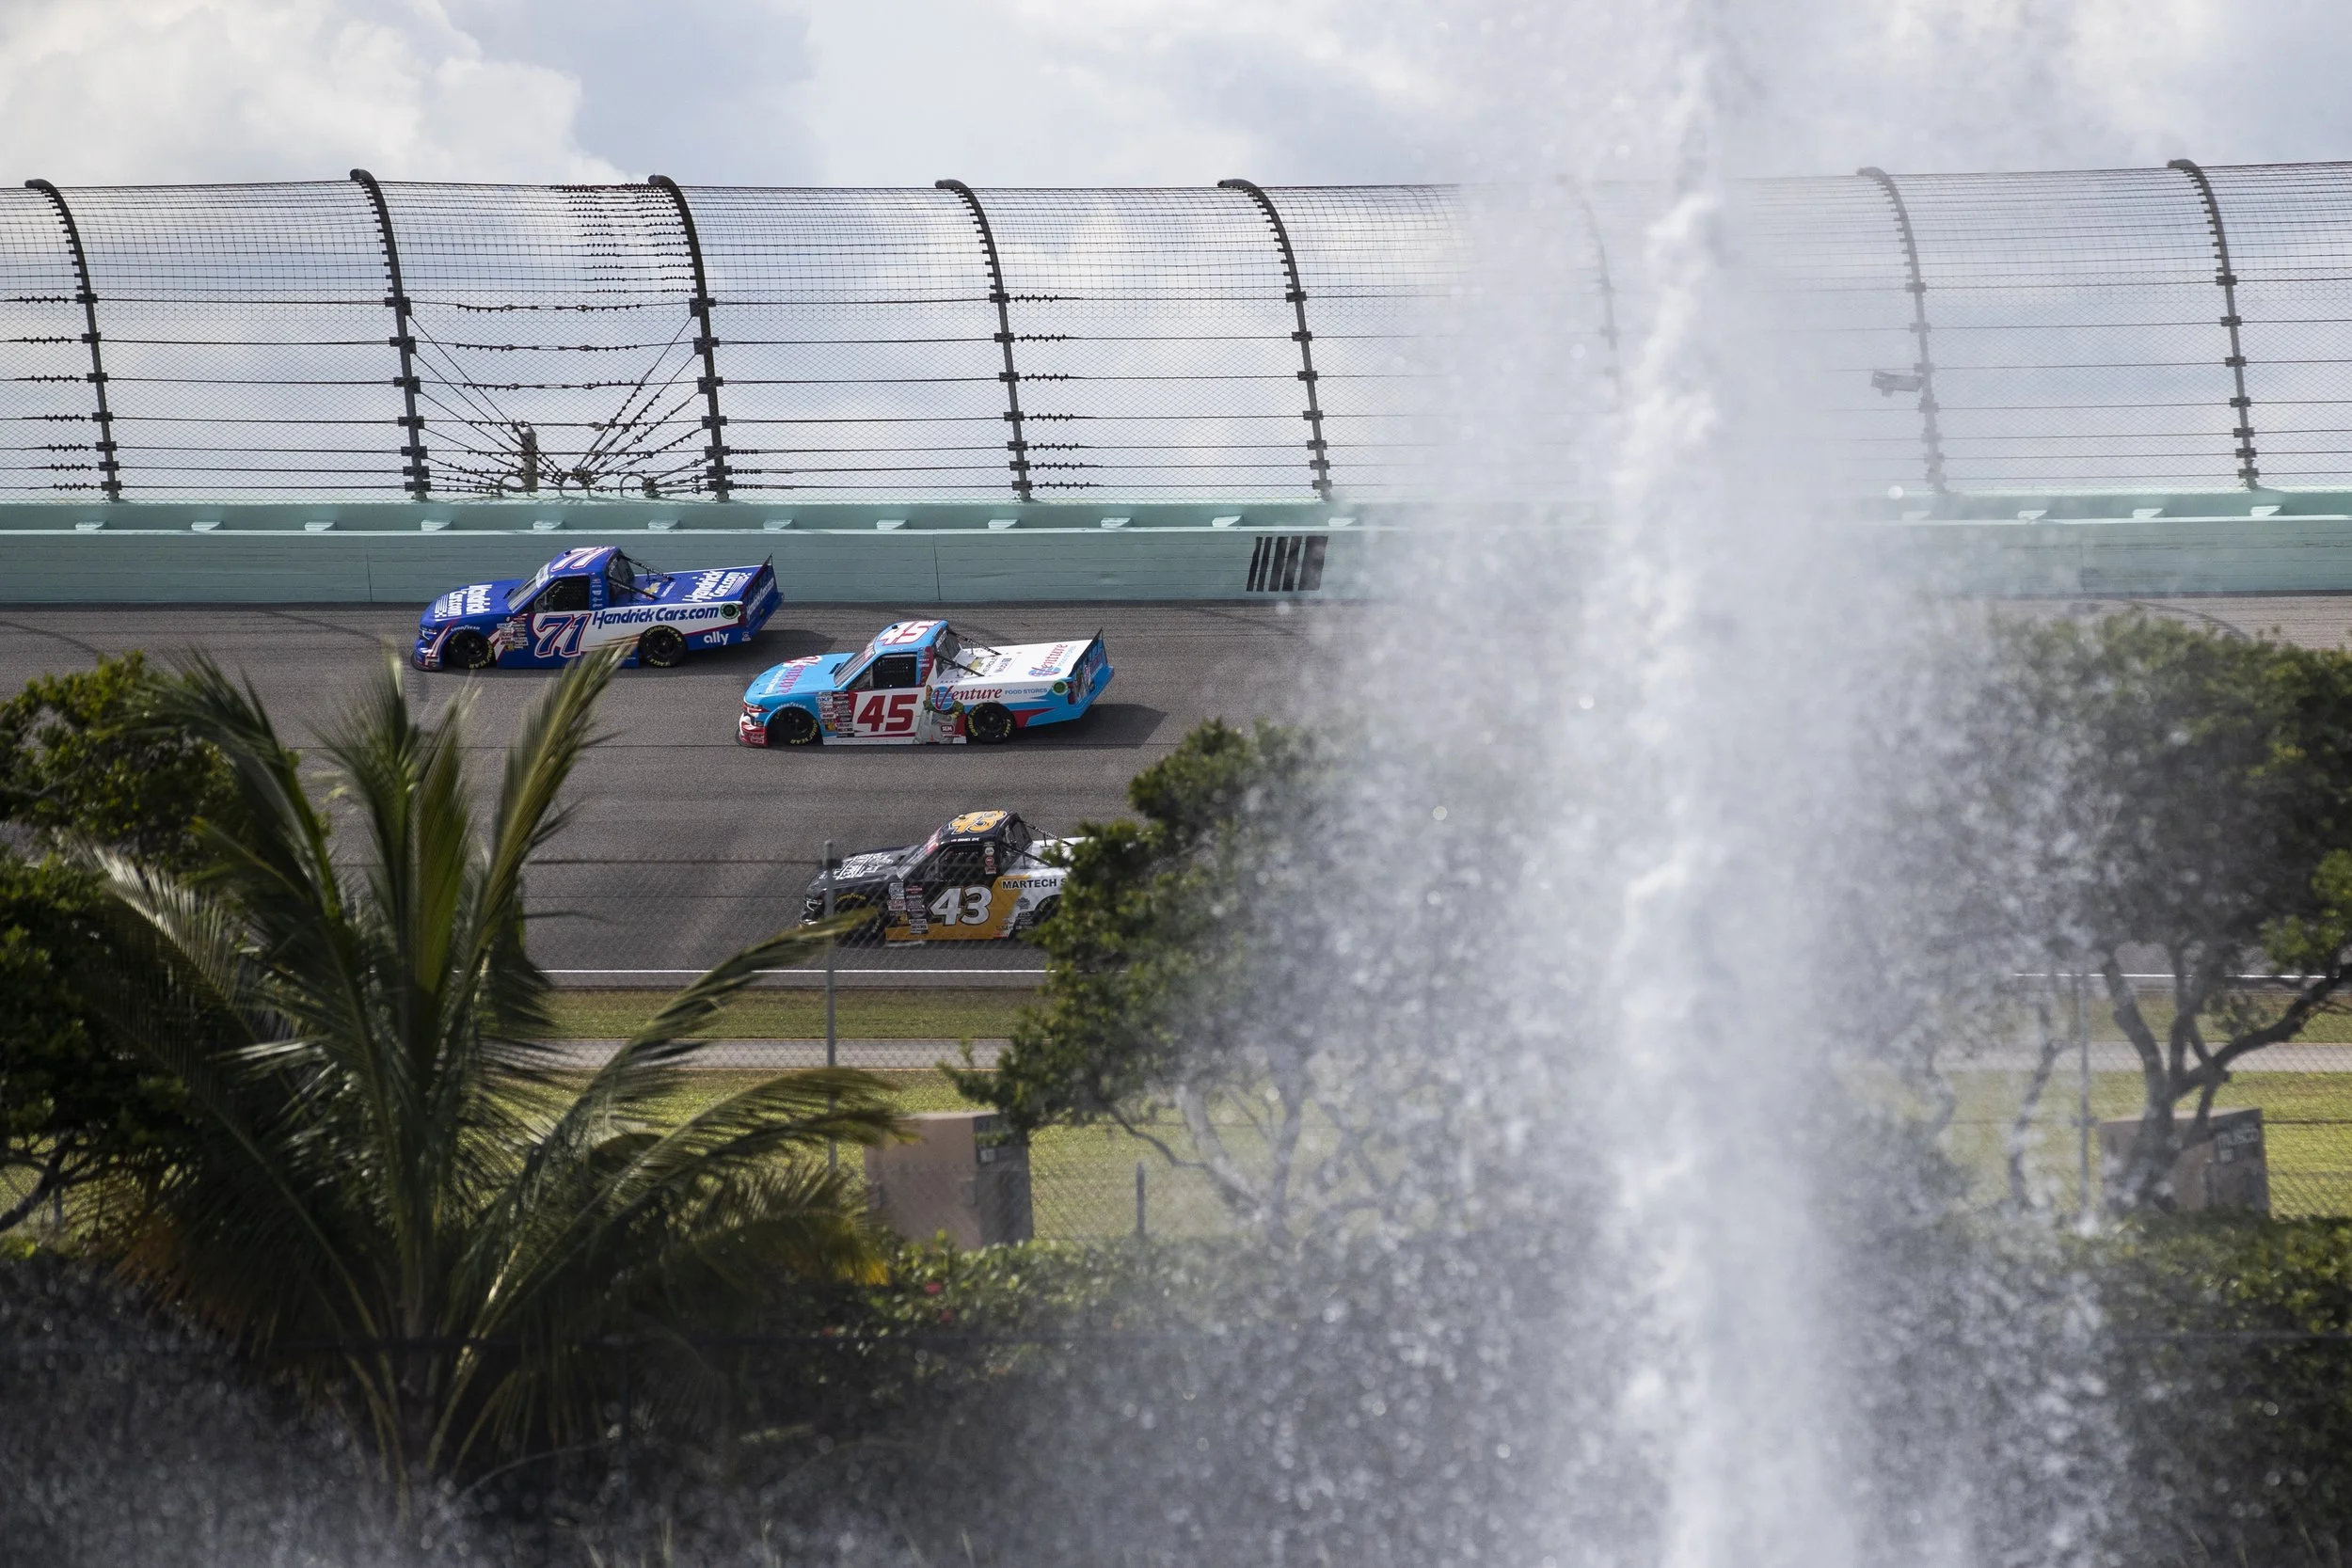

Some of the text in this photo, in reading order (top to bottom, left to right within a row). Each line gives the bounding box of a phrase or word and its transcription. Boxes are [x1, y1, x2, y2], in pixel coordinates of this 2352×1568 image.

[550, 546, 616, 573] 71
[591, 607, 720, 629] Hendrick Cars.com
[534, 613, 592, 658] 71
[703, 630, 730, 645] ally
[877, 620, 939, 647] 45
[931, 685, 1003, 711] Venture
[857, 693, 919, 733] 45
[949, 810, 1008, 835] 43
[1002, 879, 1057, 890] MARTECH
[927, 884, 994, 927] 43
